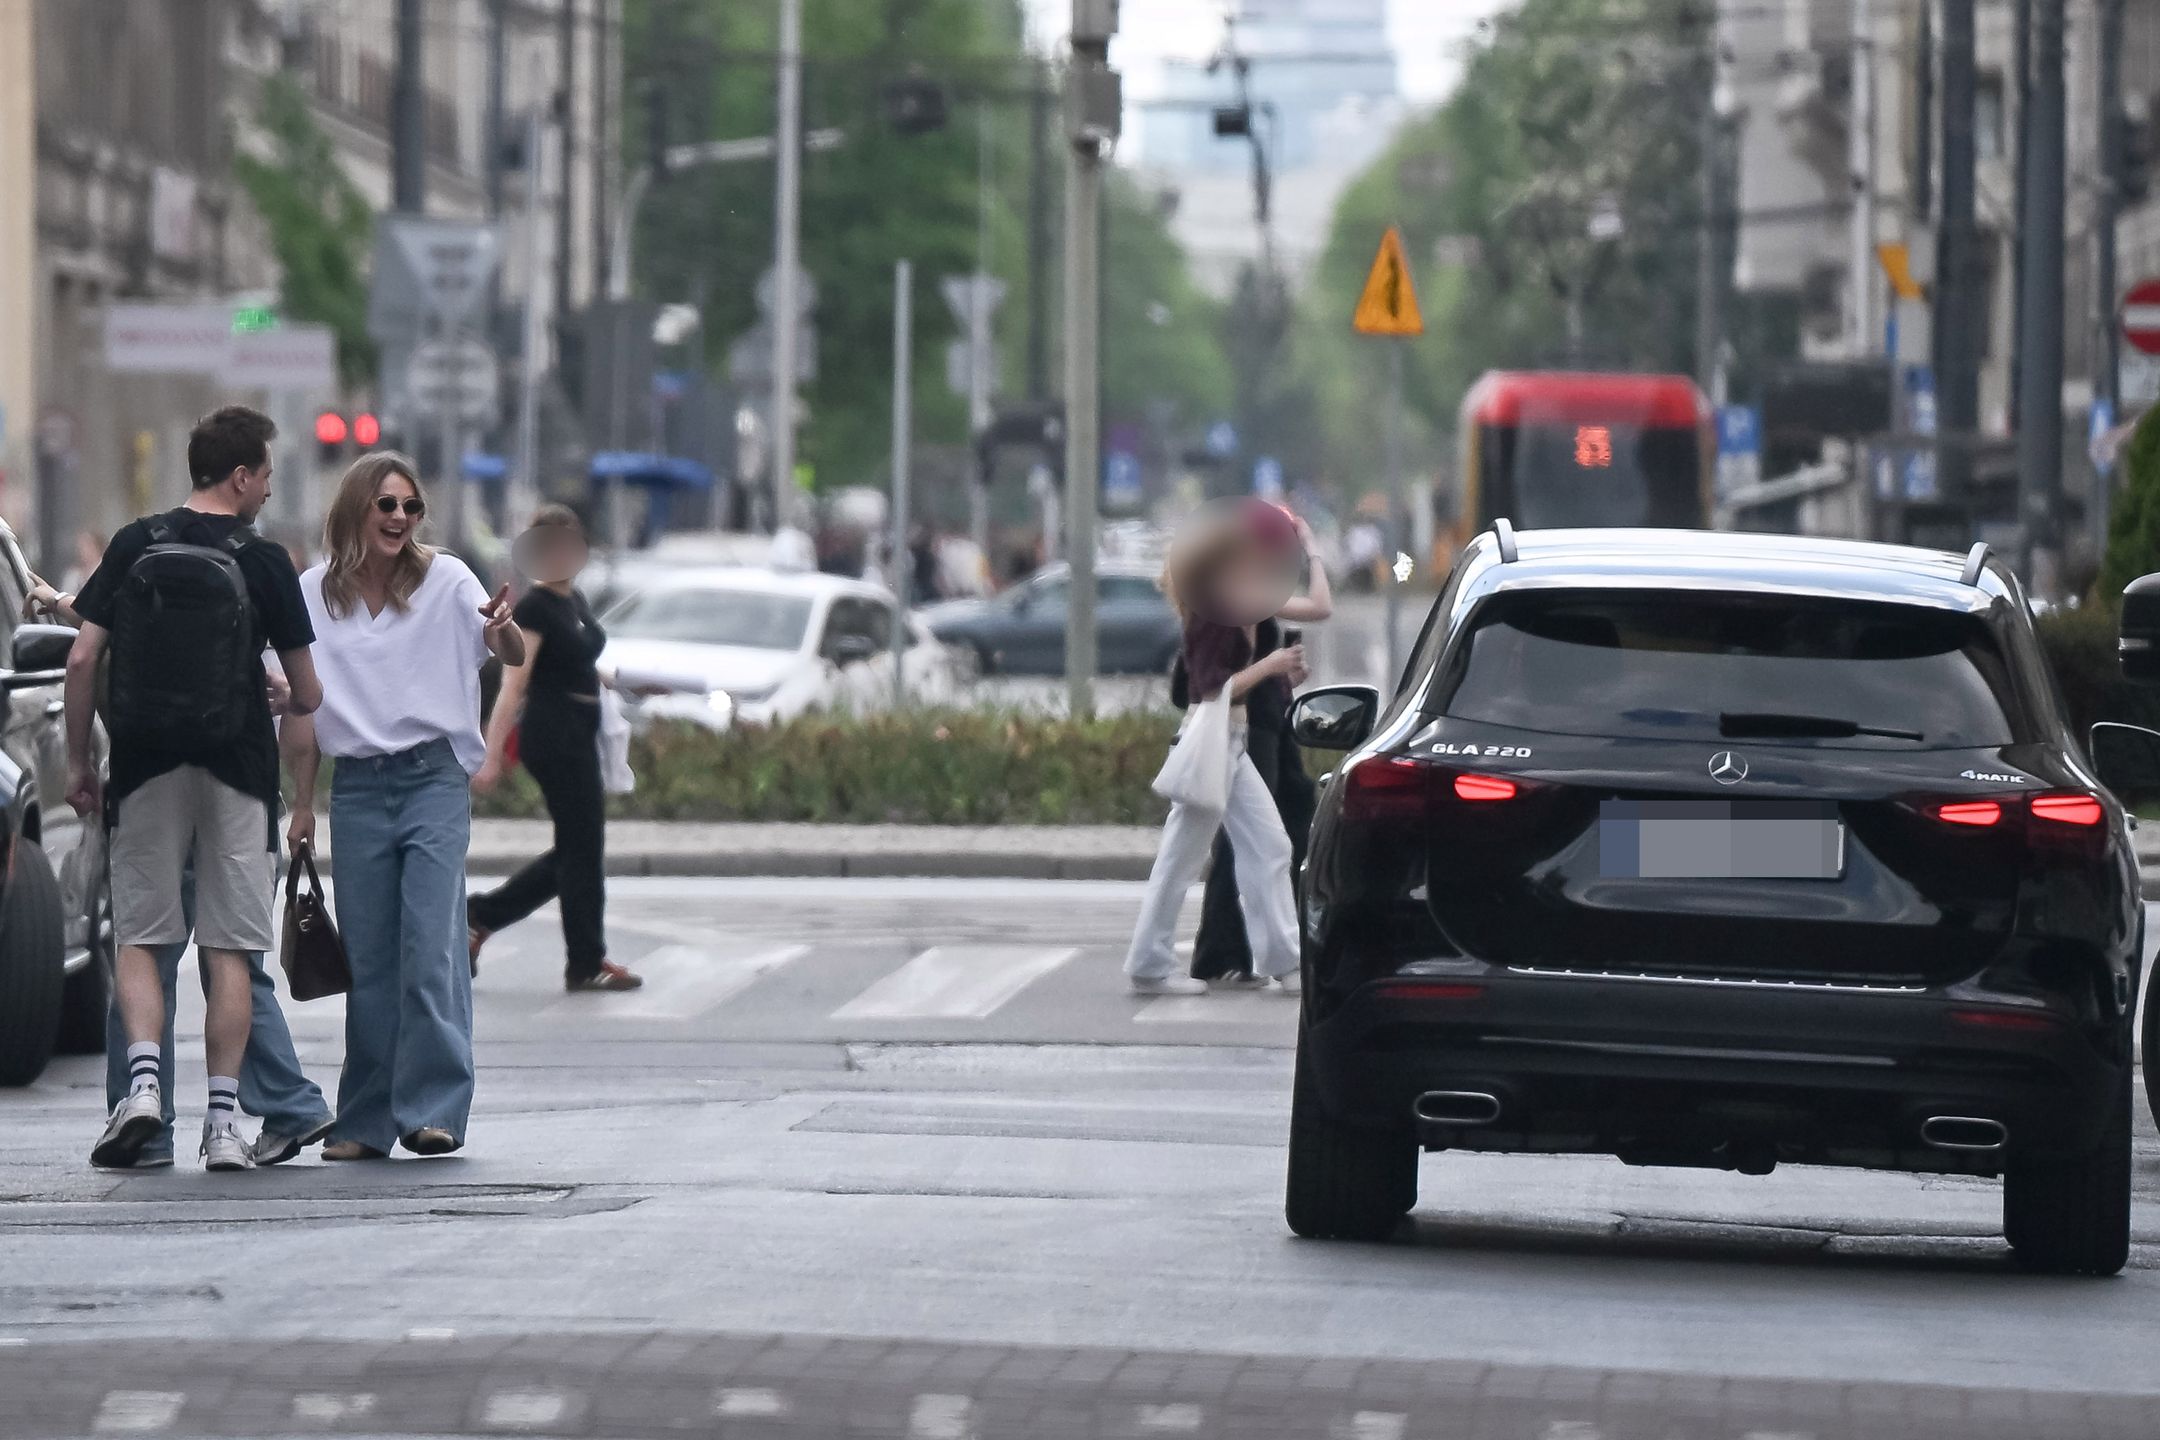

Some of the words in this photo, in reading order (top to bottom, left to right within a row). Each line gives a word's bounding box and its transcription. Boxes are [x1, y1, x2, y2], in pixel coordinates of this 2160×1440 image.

[1431, 743, 1479, 755] GLA
[1484, 745, 1531, 758] 220
[1960, 769, 2025, 783] 4MATIC
